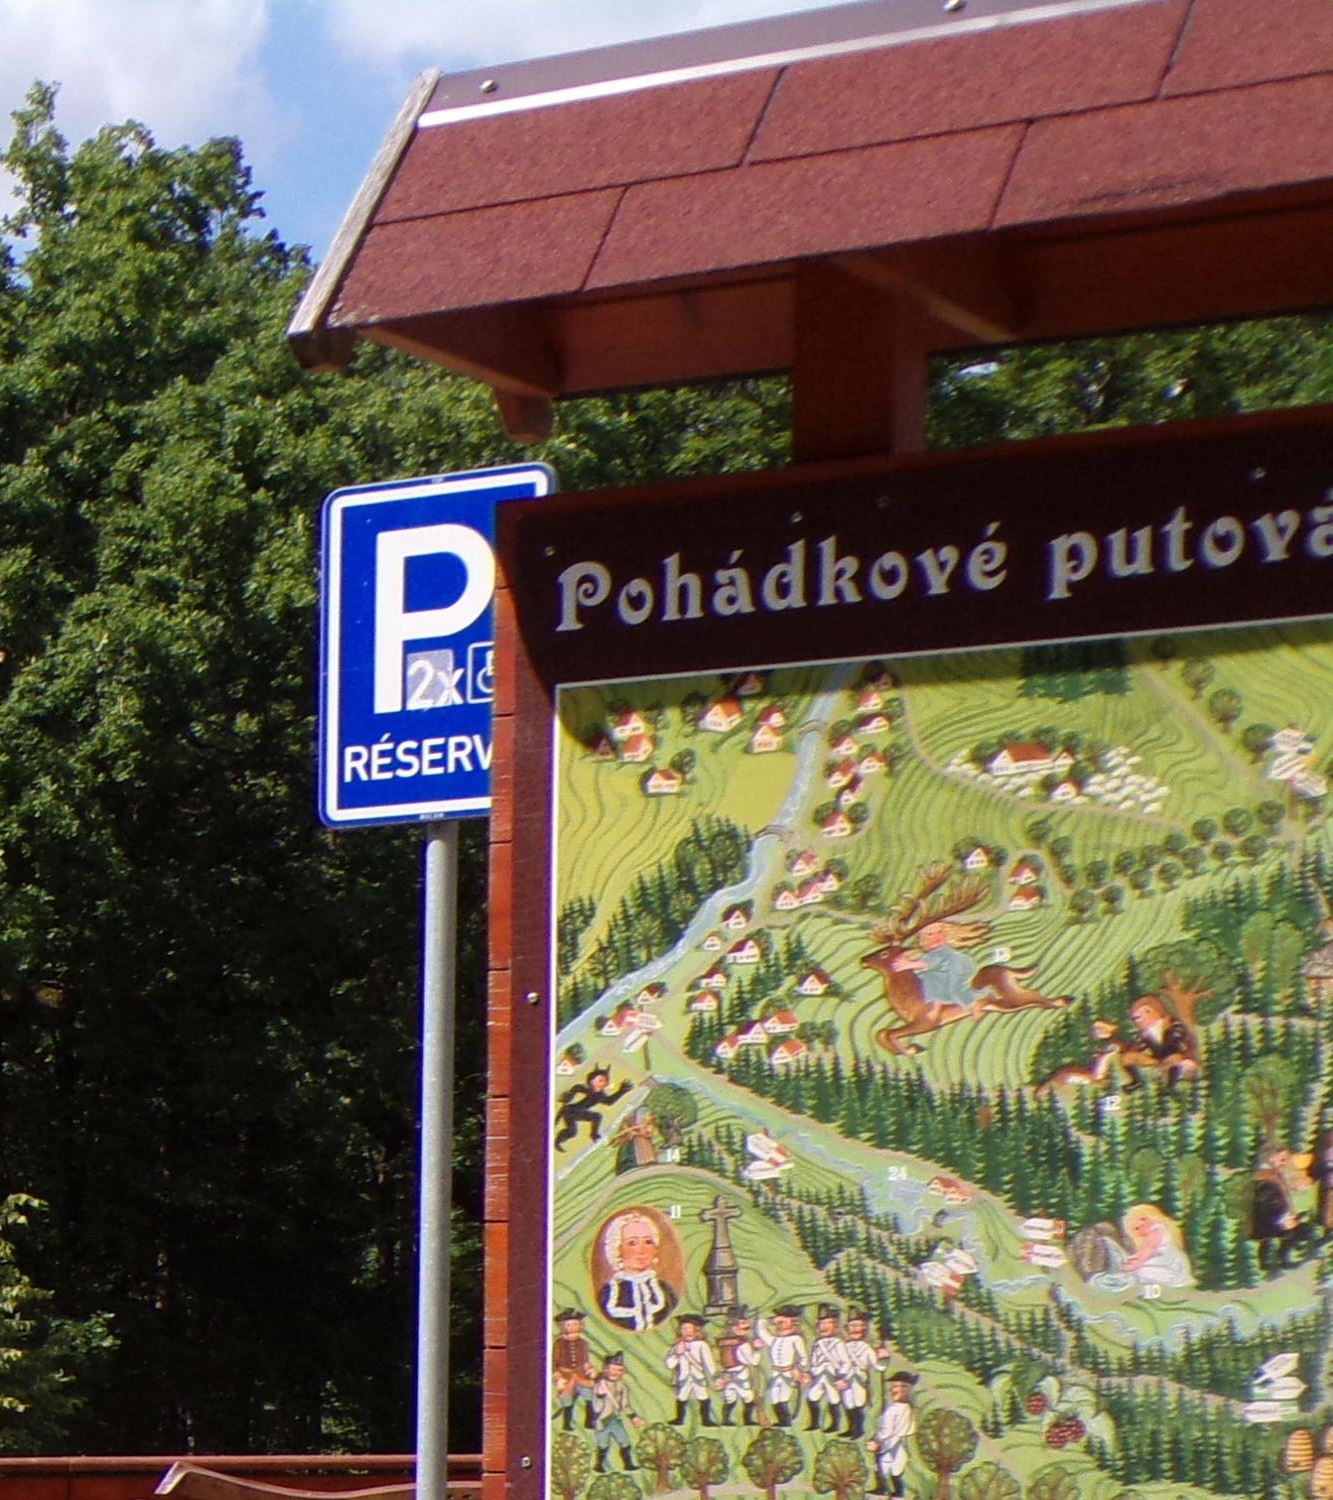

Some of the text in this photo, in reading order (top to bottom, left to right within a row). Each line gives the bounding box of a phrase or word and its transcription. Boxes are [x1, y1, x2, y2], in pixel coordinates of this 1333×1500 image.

[556, 521, 1009, 632] Pohádkové
[374, 523, 495, 714] P
[407, 657, 465, 711] 2x
[343, 732, 494, 783] RÉSERV
